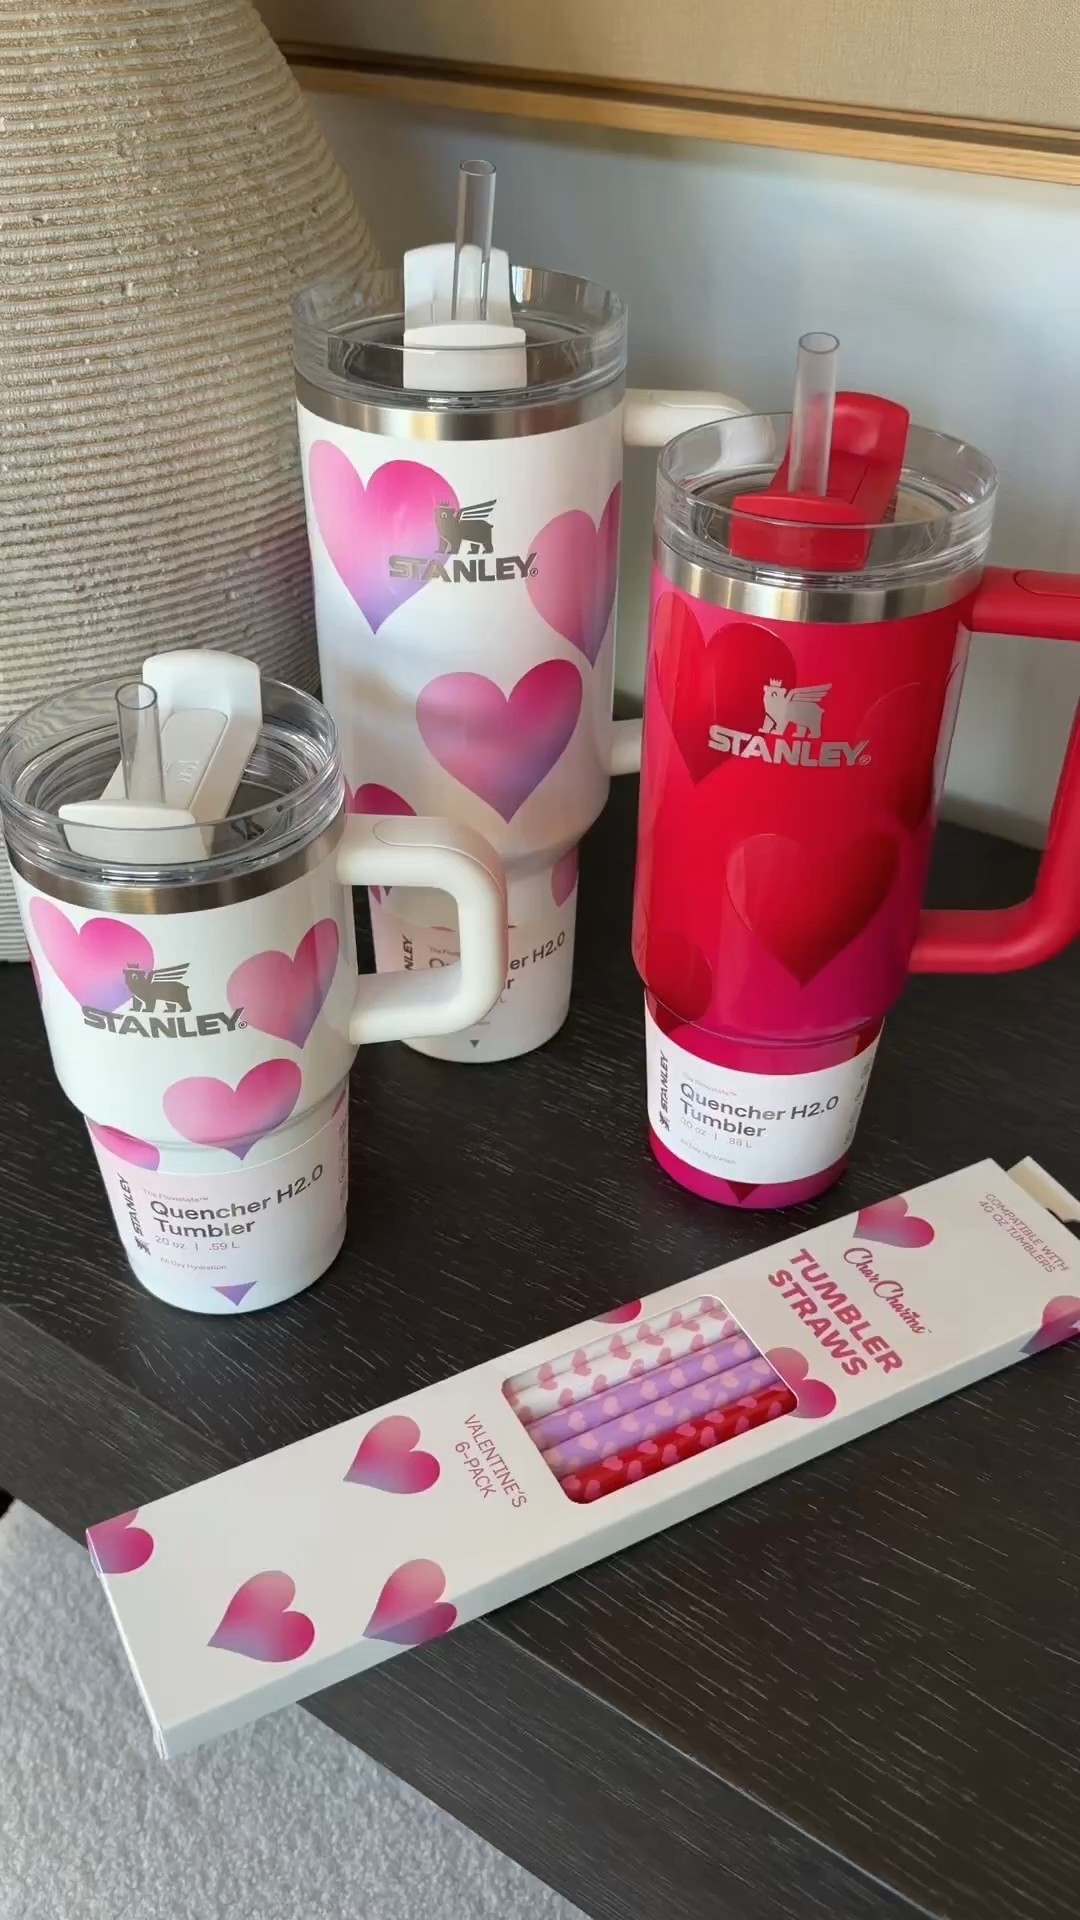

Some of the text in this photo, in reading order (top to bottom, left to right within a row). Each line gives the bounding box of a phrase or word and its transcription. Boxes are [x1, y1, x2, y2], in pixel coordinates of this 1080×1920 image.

[533, 931, 565, 963] H2.0
[659, 1050, 669, 1113] STANLEY
[680, 1083, 786, 1121] Quencher
[790, 1096, 839, 1120] H2.0
[680, 1098, 766, 1137] Tumbler
[117, 1173, 145, 1237] STANLEY
[150, 1195, 272, 1220] Quencher
[276, 1164, 324, 1204] H2.0
[152, 1216, 256, 1238] Tumbler
[154, 1235, 170, 1246] 20
[172, 1241, 186, 1250] oz
[208, 1242, 228, 1251] .59
[231, 1241, 241, 1249] L
[978, 1200, 995, 1214] 40
[1006, 1225, 1056, 1273] TUMBLERS
[984, 1192, 1071, 1272] COMPATIBLE WITH
[768, 1269, 868, 1376] STRAWS
[789, 1248, 903, 1374] TUMBLER
[455, 1441, 497, 1499] 6-PACK
[463, 1413, 528, 1509] VALENTINE'S
